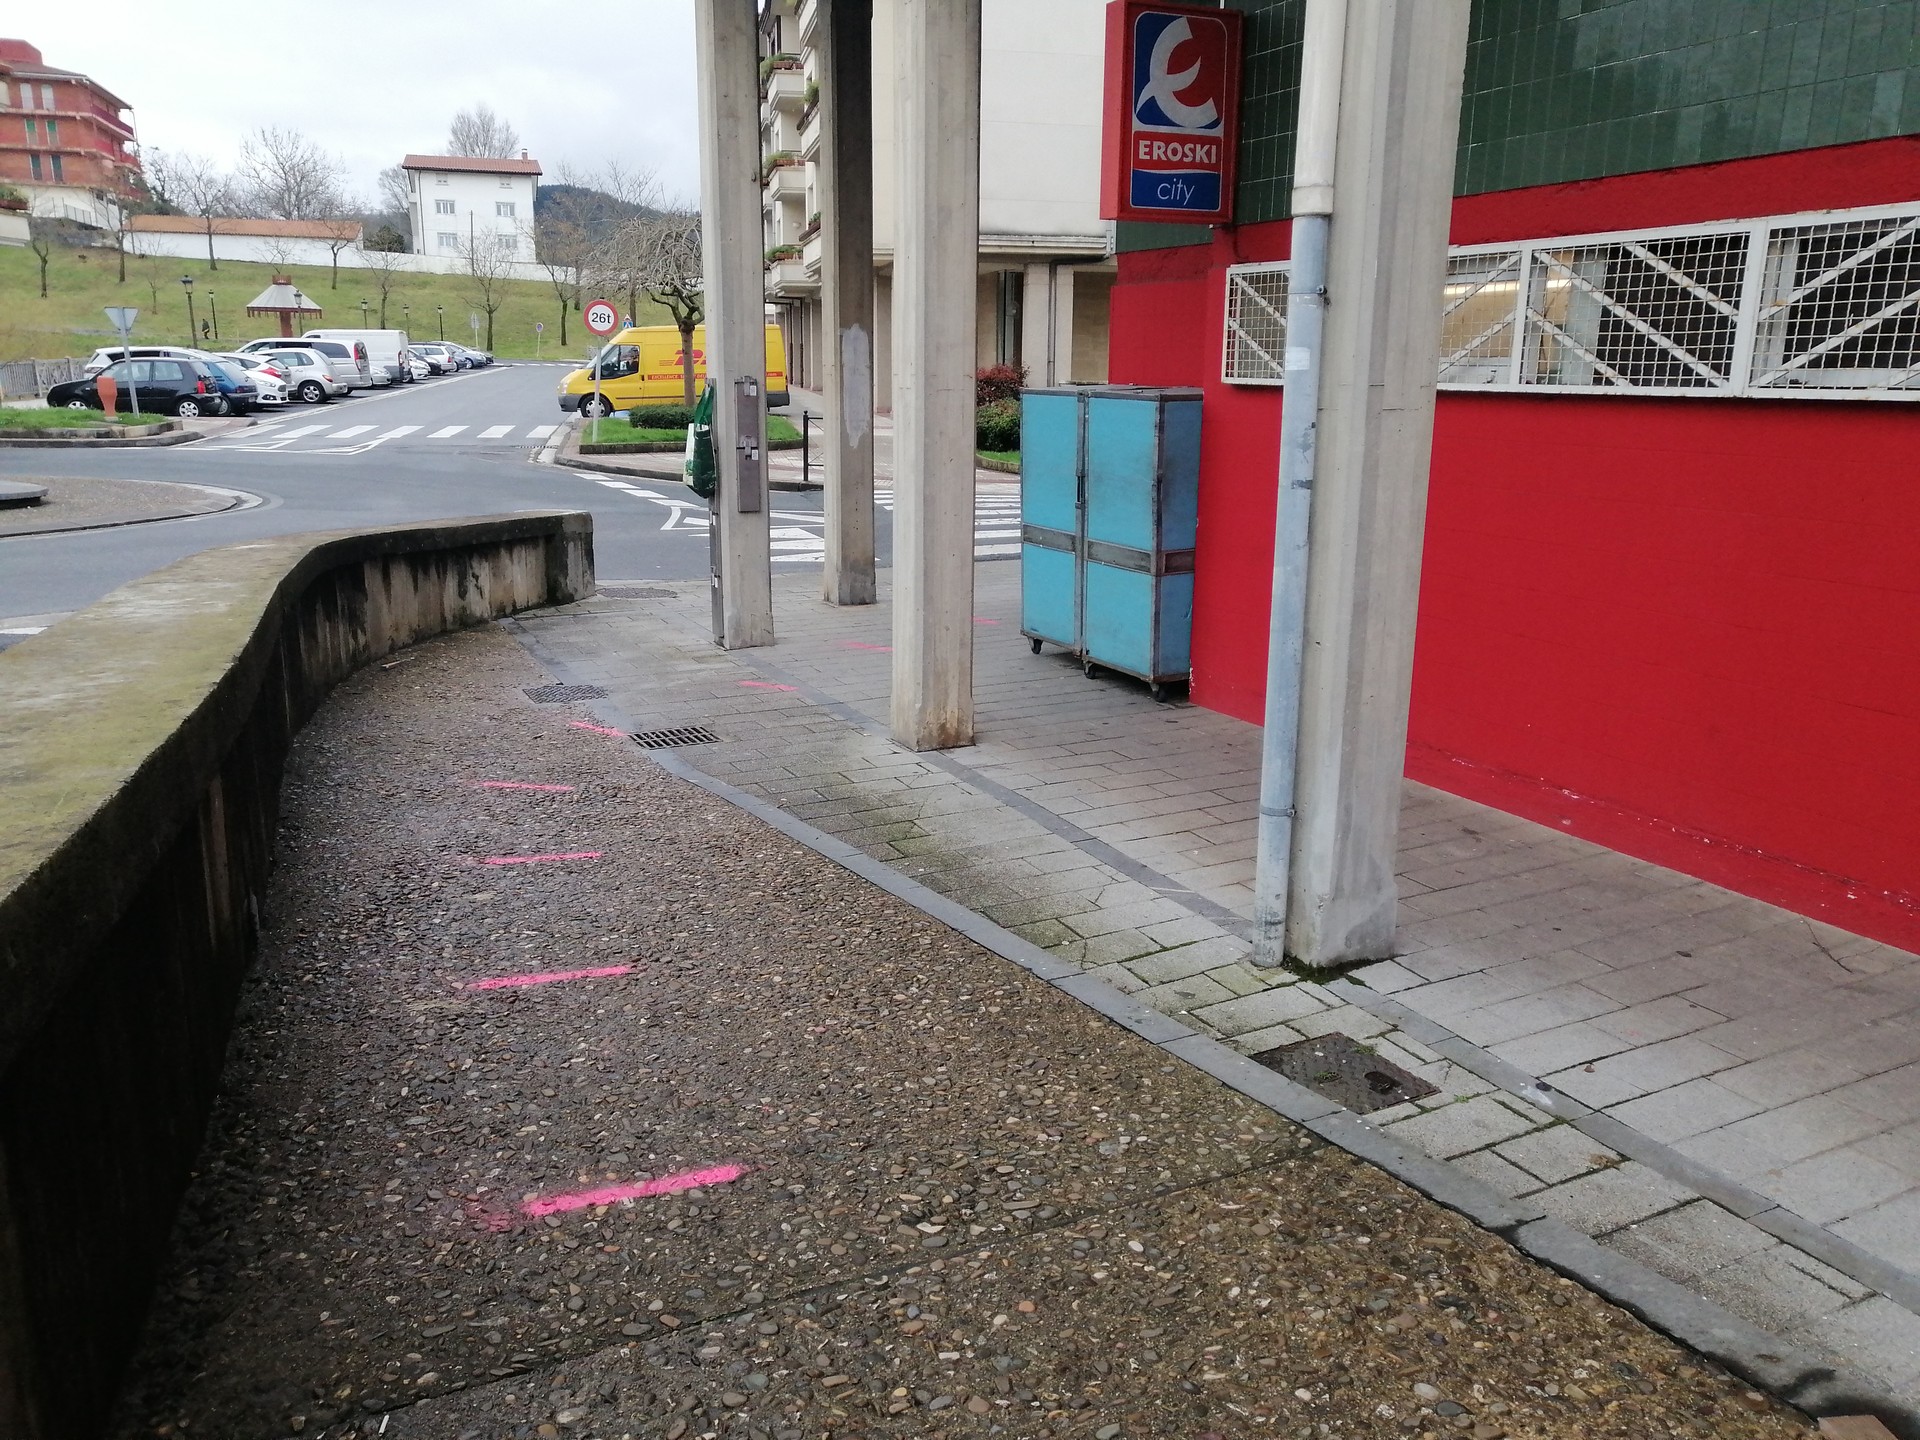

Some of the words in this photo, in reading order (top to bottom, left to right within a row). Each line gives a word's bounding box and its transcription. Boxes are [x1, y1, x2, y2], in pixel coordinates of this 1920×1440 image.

[1138, 140, 1217, 164] EROSKI
[1157, 178, 1195, 206] city
[591, 312, 612, 324] 26t
